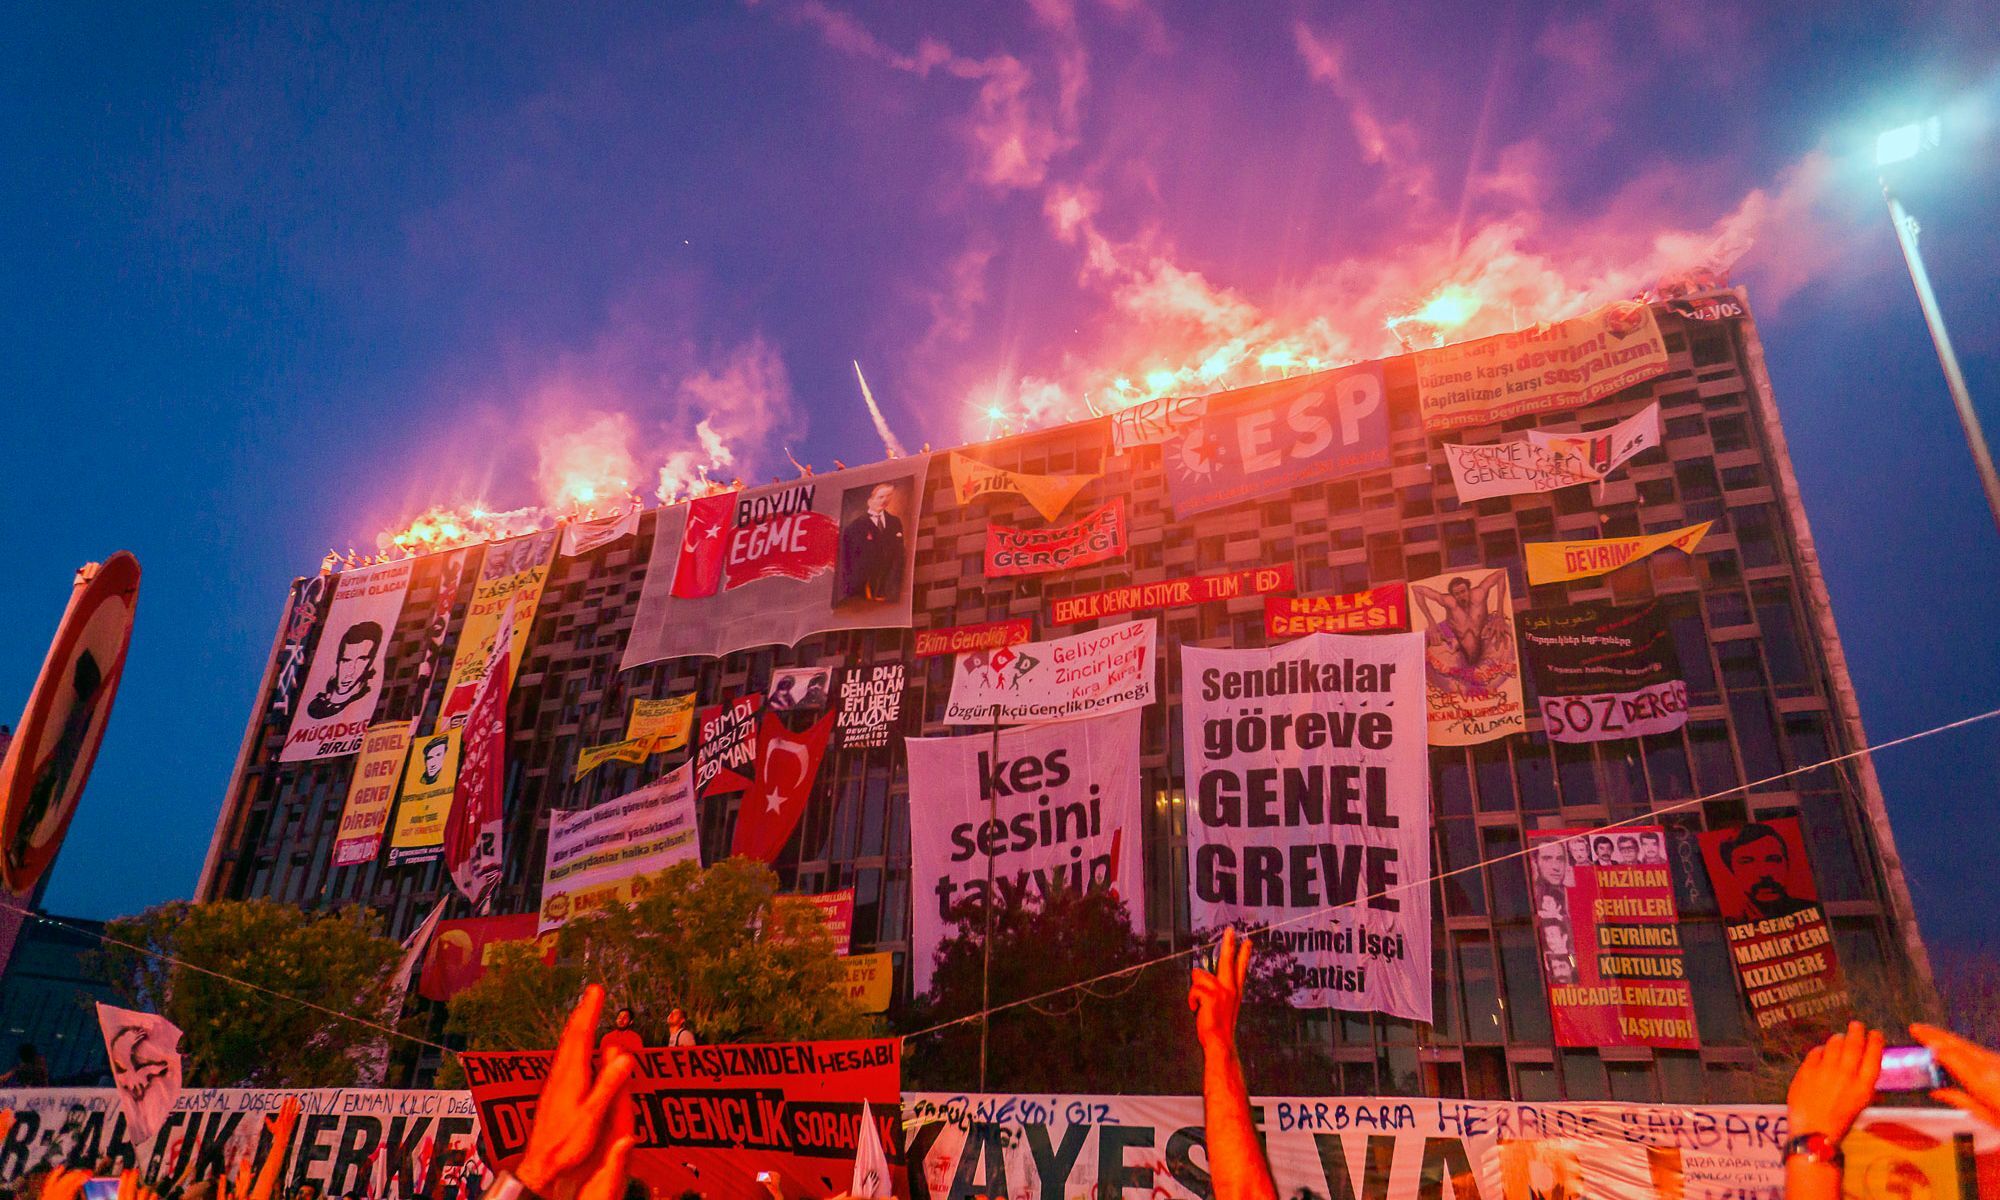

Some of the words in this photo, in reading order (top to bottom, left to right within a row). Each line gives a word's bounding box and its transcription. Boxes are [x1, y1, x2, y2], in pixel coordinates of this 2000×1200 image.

[1420, 370, 1473, 389] Düzene
[1477, 362, 1514, 380] karşı
[1517, 333, 1607, 371] devrim!
[1423, 386, 1503, 411] Kapitalizme
[1506, 376, 1542, 394] karşı
[1544, 338, 1658, 386] sosyalizm!
[1489, 397, 1553, 421] Devrimci
[1591, 366, 1664, 397] Platformu
[1237, 373, 1380, 475] ESP
[738, 485, 815, 529] BOYUN
[730, 515, 812, 564] EĞME
[995, 527, 1120, 567] GERÇEĞİ
[1272, 606, 1398, 634] CEPHESİ
[1290, 589, 1378, 616] HALK
[916, 634, 948, 650] Ekim
[951, 627, 1009, 648] Gençliği
[1053, 623, 1144, 664] Geliyoruz
[1055, 646, 1138, 685] Zincirleri
[1202, 659, 1396, 701] Sendikalar
[844, 697, 865, 712] EM
[1029, 700, 1083, 718] Gençlik
[1083, 682, 1151, 711] Derneği
[1545, 695, 1624, 735] SÖZ
[367, 734, 404, 753] GENEL
[1203, 708, 1394, 760] göreve
[364, 760, 397, 778] GREV
[977, 749, 1071, 800] kes
[1199, 765, 1400, 829] GENEL
[950, 784, 1101, 862] sesini
[571, 853, 619, 871] meydanlar
[622, 846, 650, 859] halka
[1195, 843, 1400, 913] GREVE
[1599, 869, 1669, 887] HAZİRAN
[1595, 896, 1673, 917] ŞEHİTLERİ
[1268, 926, 1353, 956] evrimci
[1358, 924, 1404, 960] İşçi
[1600, 924, 1679, 946] DEVRİMCİ
[1600, 956, 1684, 979] KURTULUŞ
[1742, 953, 1827, 989] KIZILDERE
[1551, 984, 1689, 1007] MÜCADELEMİZDE
[1619, 1017, 1694, 1039] YAŞIYOR!
[643, 1051, 672, 1078] VE
[672, 1045, 816, 1083] FAŞİZMDEN
[819, 1044, 894, 1075] HESABI
[661, 1091, 792, 1150] GENÇLİK
[794, 1110, 897, 1156] SORACK
[1277, 1102, 1416, 1132] BARBARA
